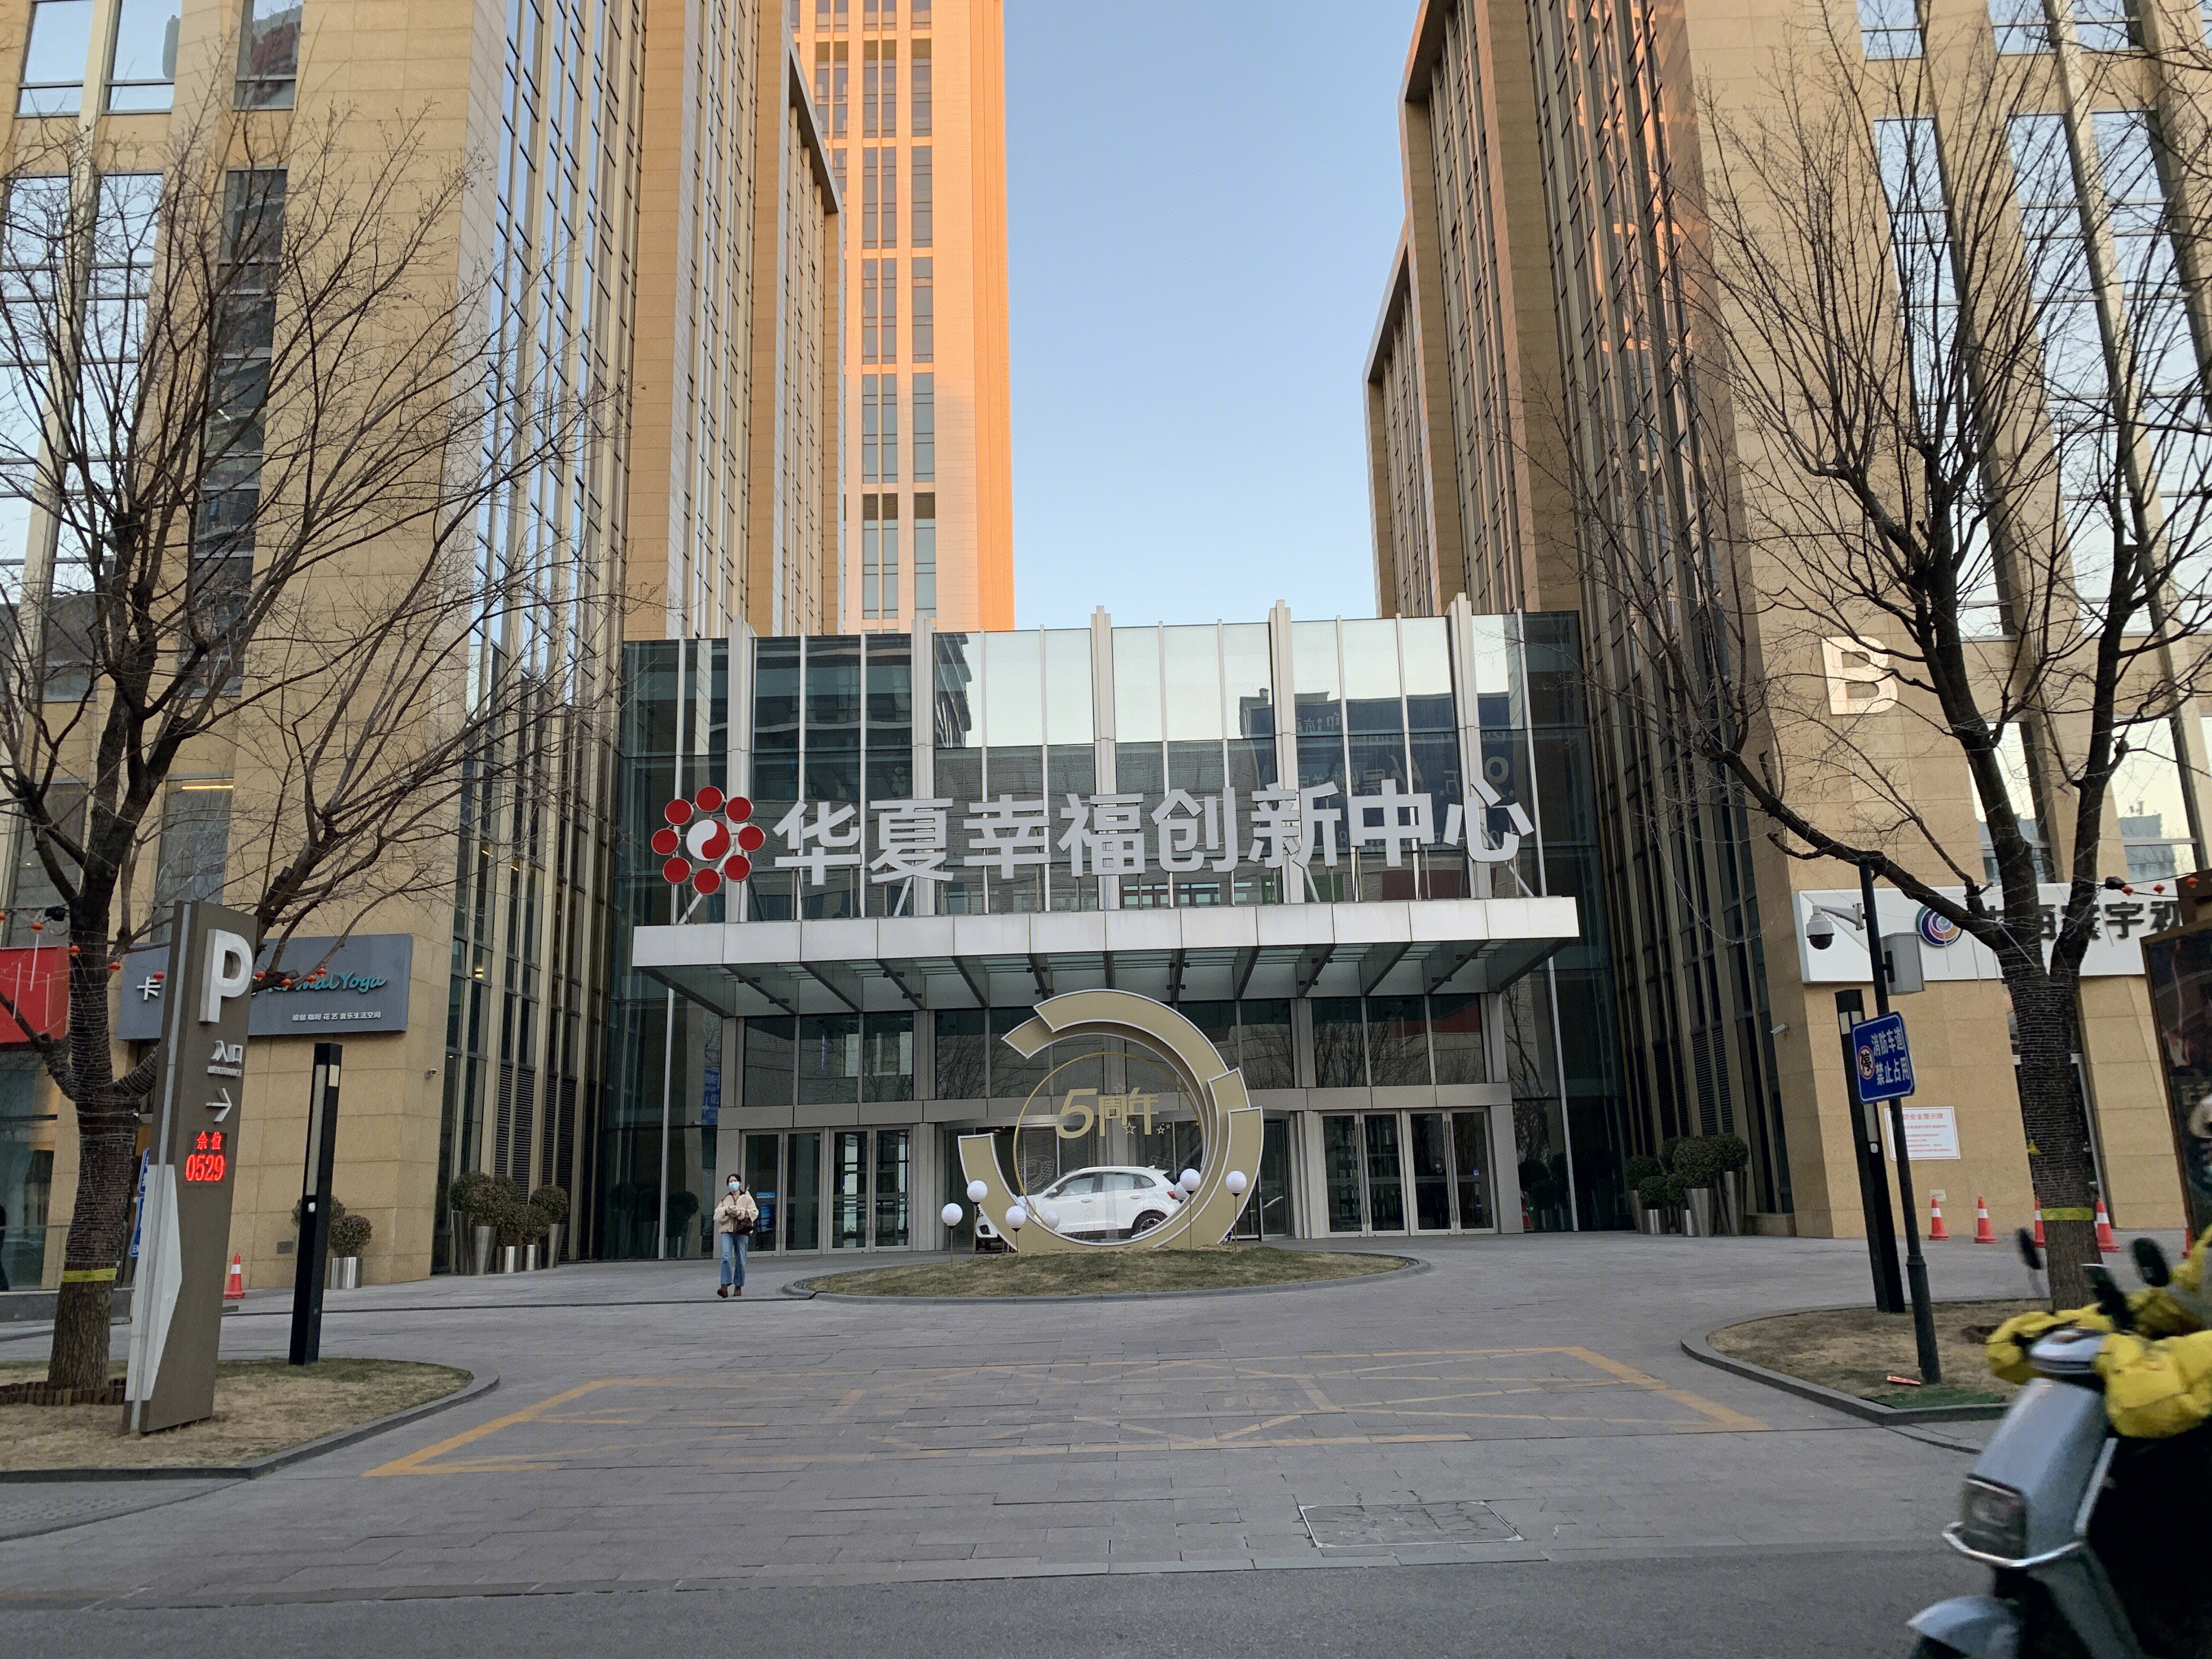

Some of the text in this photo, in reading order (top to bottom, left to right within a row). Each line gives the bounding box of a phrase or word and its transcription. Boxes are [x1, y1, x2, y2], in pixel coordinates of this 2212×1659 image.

[1821, 635, 1898, 716] B
[772, 778, 1534, 886] 华夏幸福创新中心
[199, 929, 253, 1023] P
[211, 1040, 243, 1064] 入口
[1871, 1026, 1905, 1057] 消防车道
[207, 1065, 242, 1077] ENTRANCE
[1875, 1057, 1911, 1086] 禁止占用
[1056, 1087, 1159, 1139] 5周年
[196, 1131, 222, 1150] 余位
[185, 1154, 225, 1181] 0529
